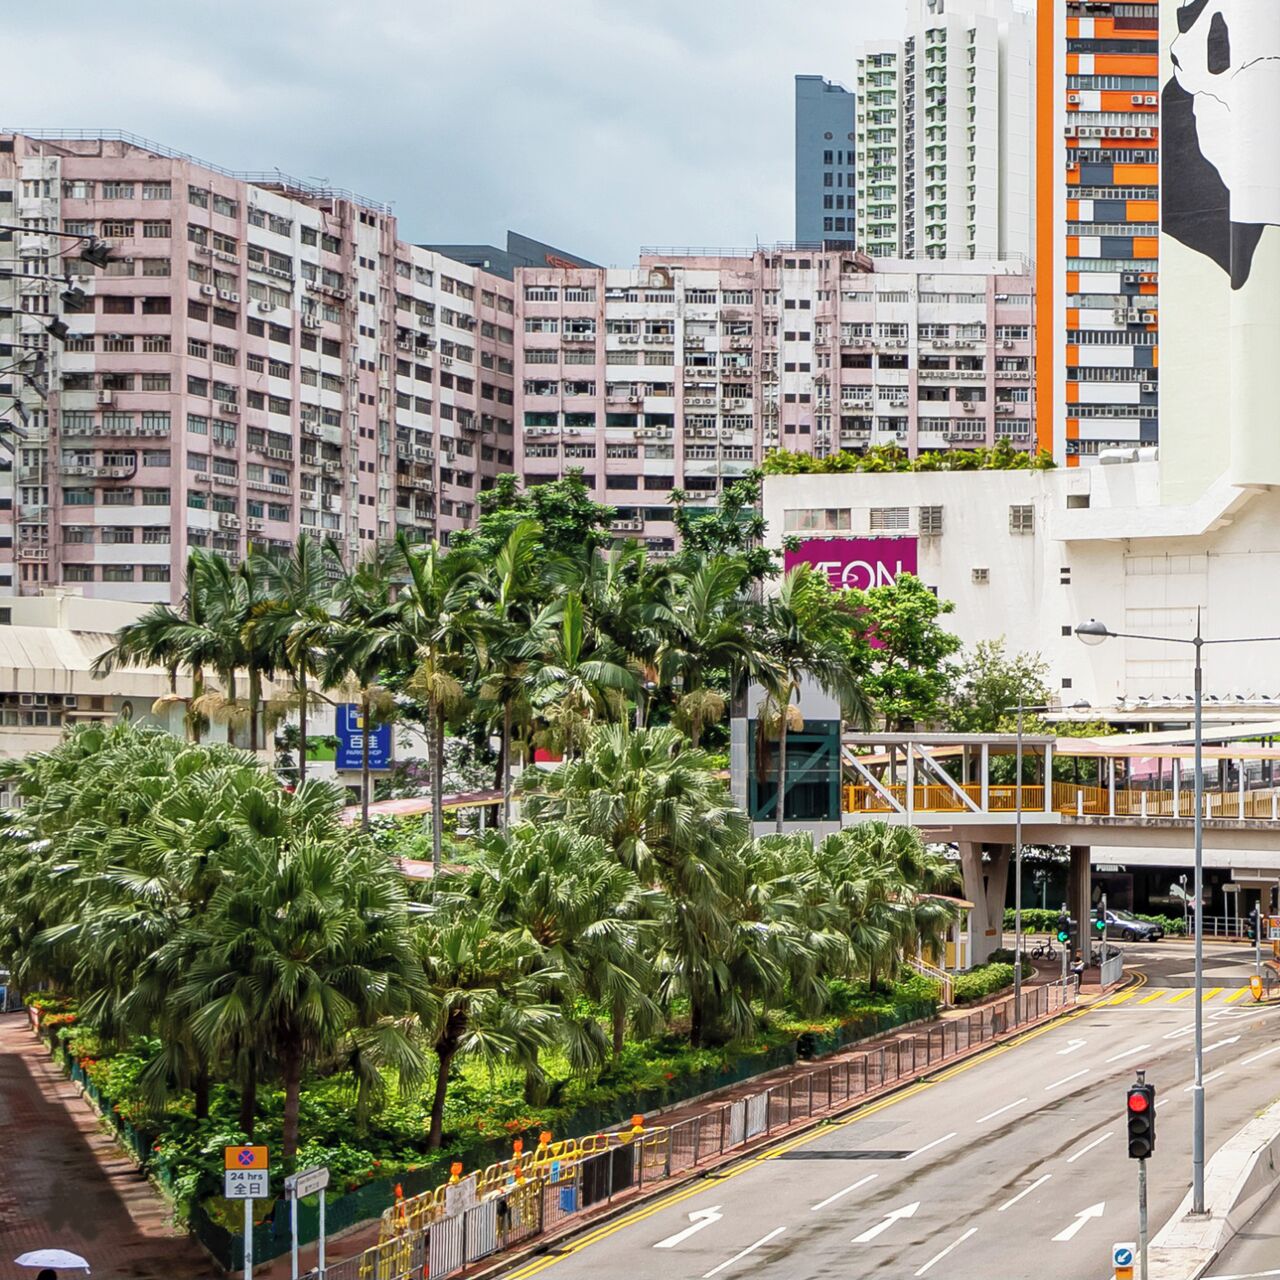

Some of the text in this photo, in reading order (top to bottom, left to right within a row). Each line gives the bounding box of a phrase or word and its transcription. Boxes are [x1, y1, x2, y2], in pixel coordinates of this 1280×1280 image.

[230, 1171, 263, 1181] 24 hrs
[234, 1182, 261, 1195] 全日
